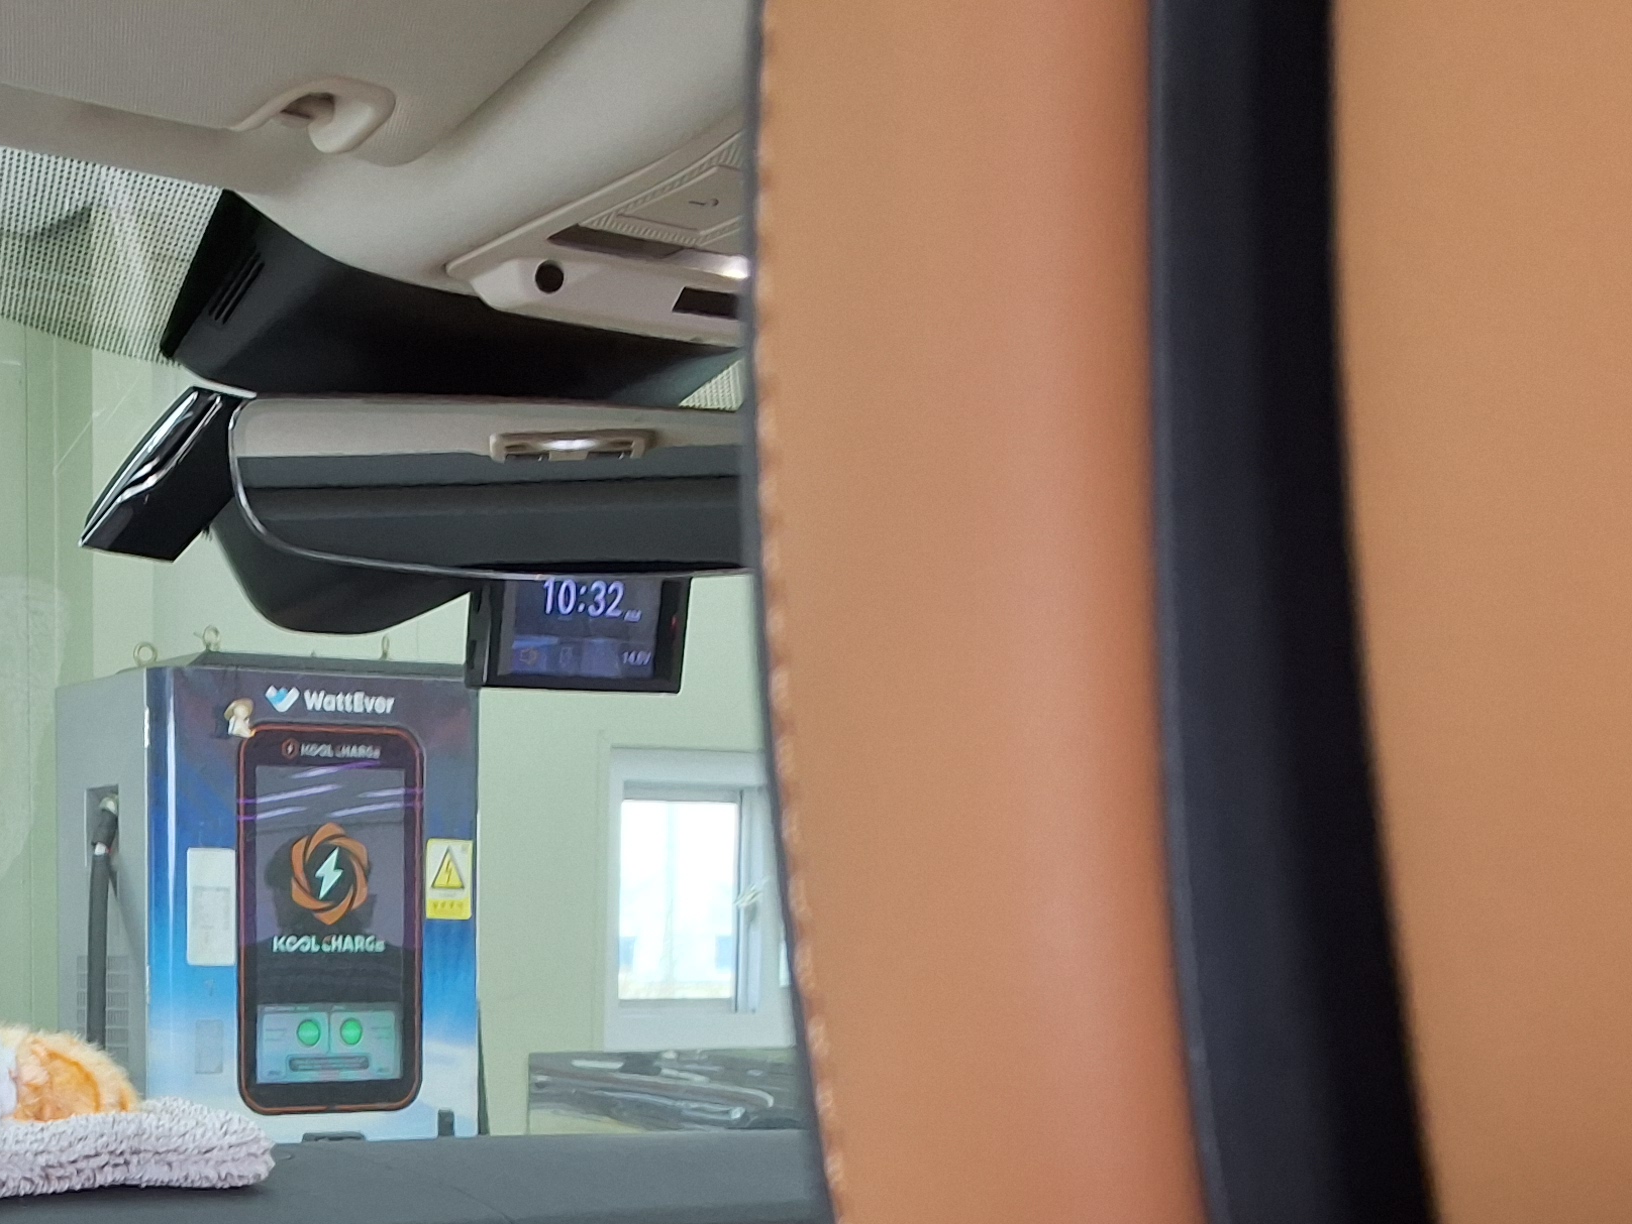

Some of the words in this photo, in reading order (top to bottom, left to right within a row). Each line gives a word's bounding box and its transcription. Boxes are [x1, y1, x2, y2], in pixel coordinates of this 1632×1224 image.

[543, 577, 624, 617] 10:32
[304, 689, 395, 714] WattEver
[300, 743, 334, 758] KOOL
[273, 935, 320, 953] KOOL
